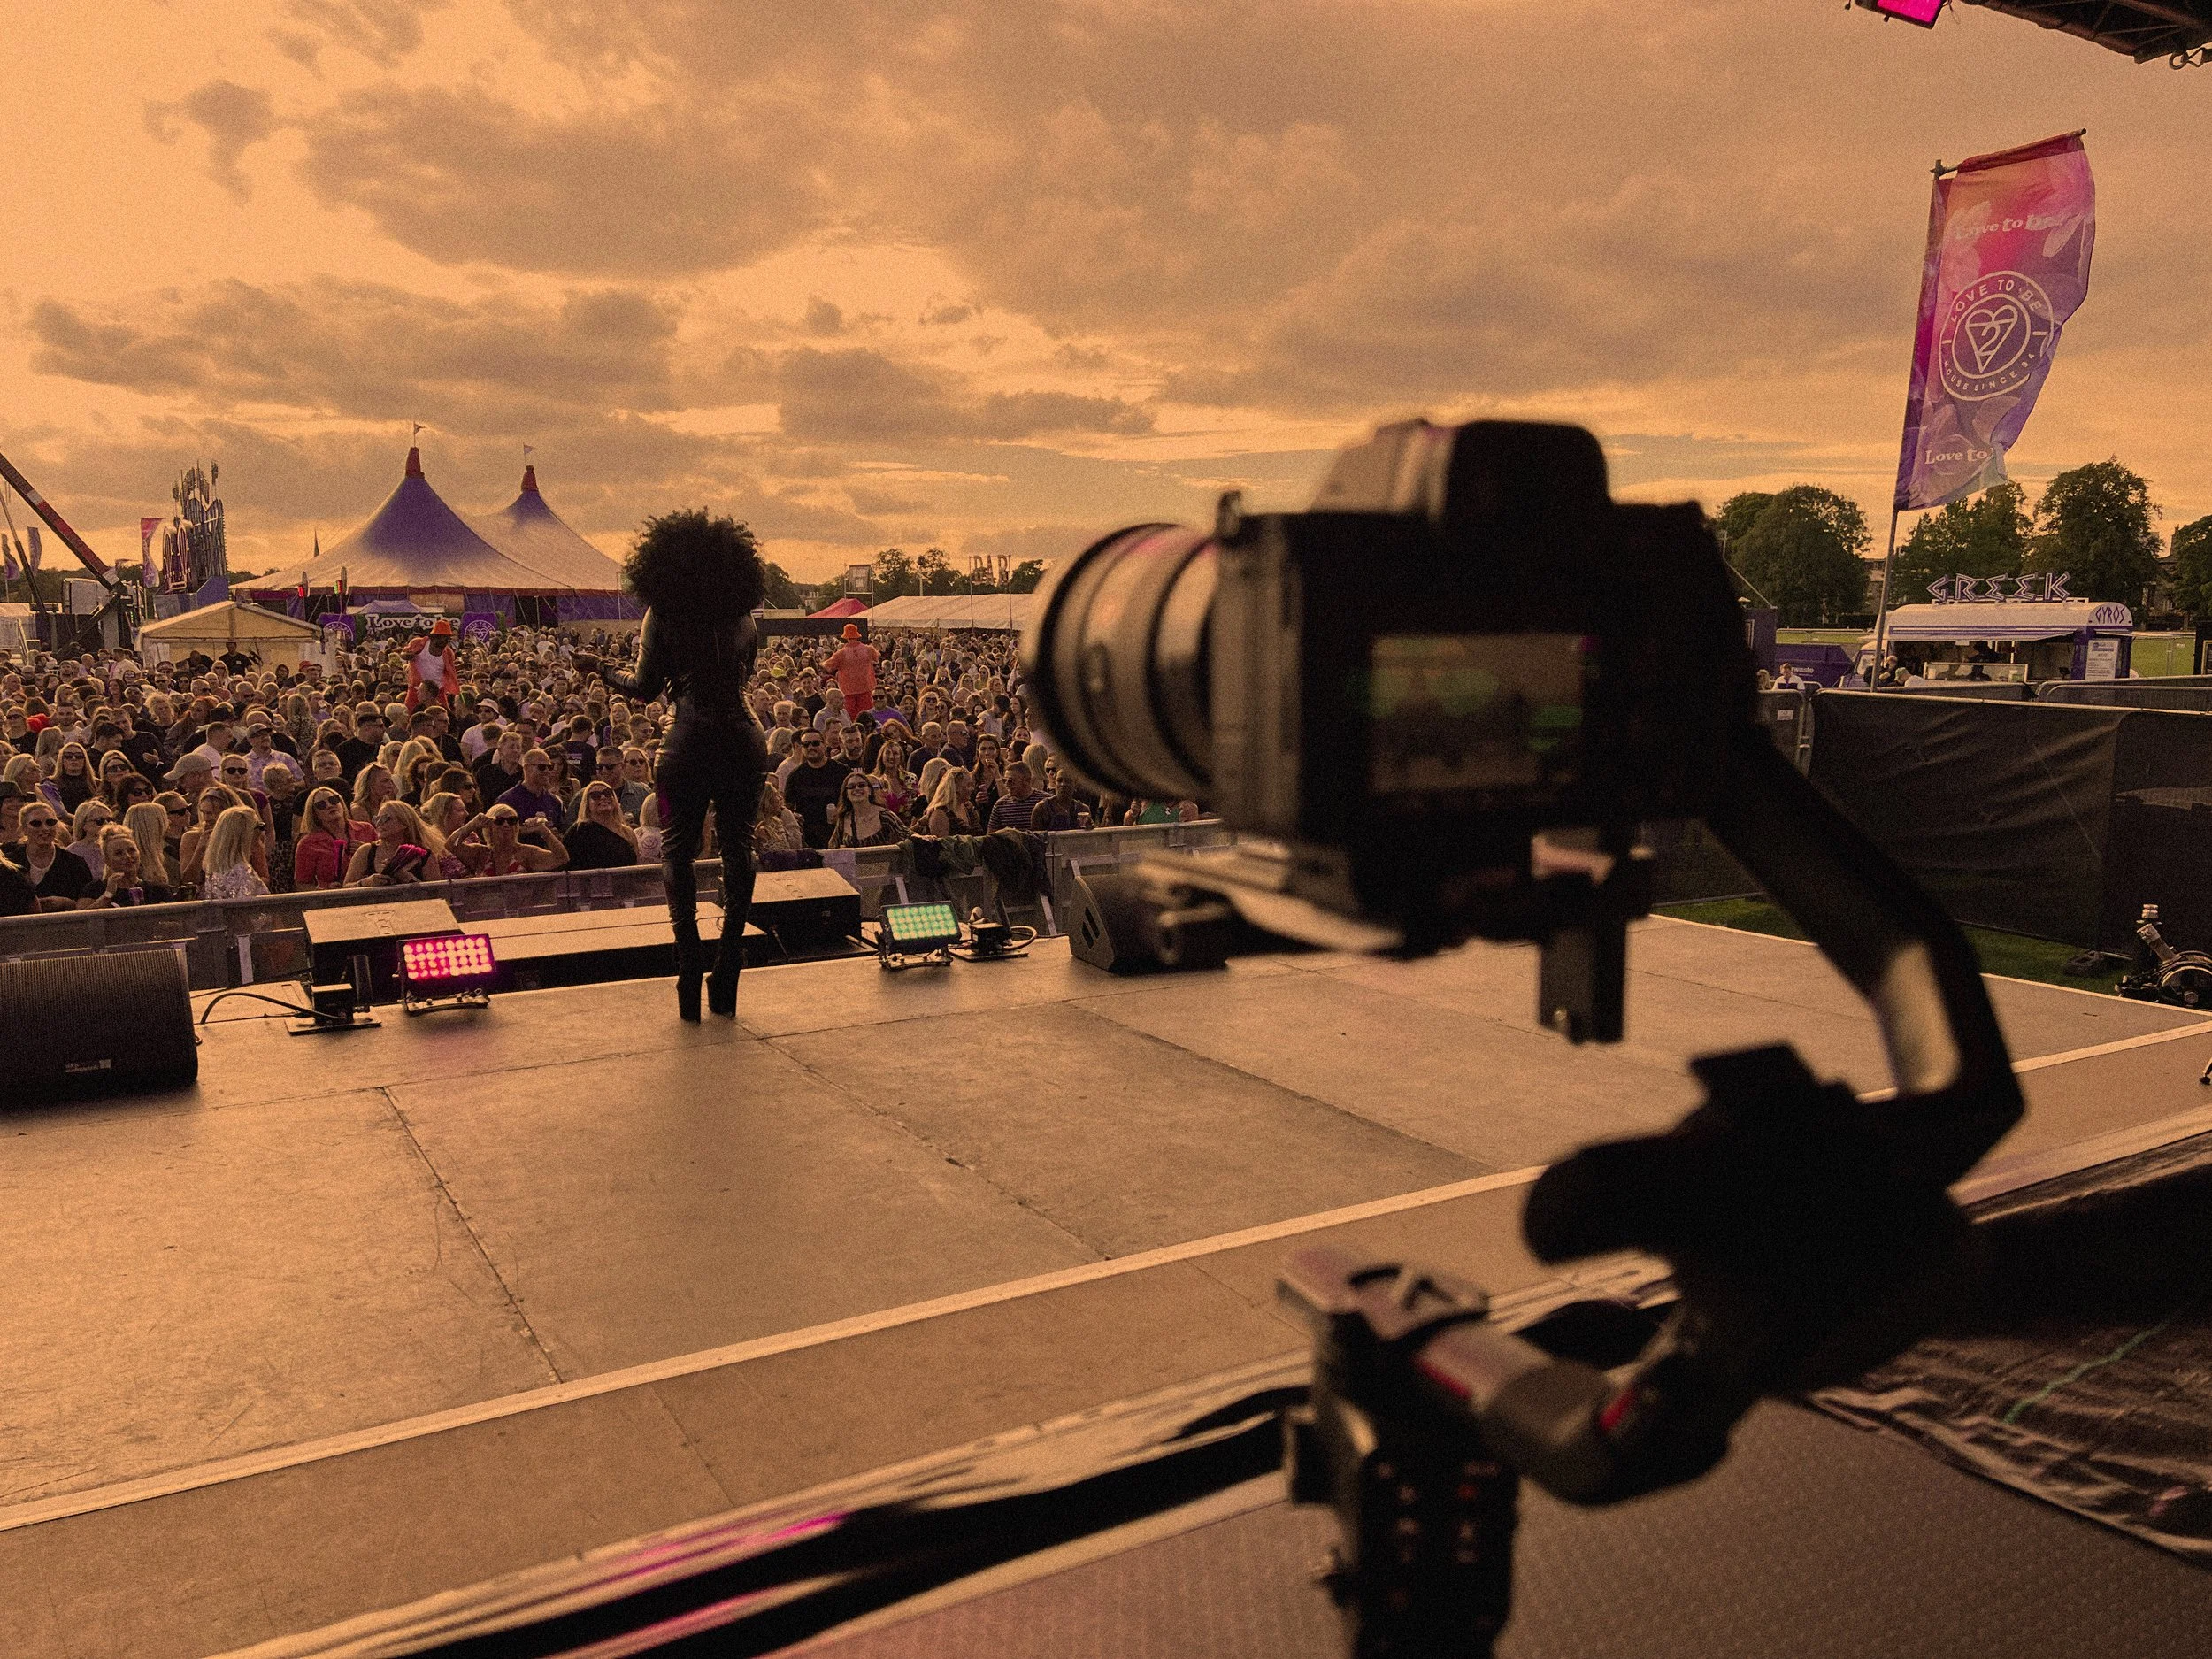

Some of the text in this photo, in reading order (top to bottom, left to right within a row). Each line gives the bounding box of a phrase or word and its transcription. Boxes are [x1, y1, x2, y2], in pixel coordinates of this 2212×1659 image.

[2002, 217, 2024, 232] to
[1950, 279, 2042, 323] LOVE TO BE
[1974, 370, 2017, 391] SINCE
[1924, 449, 1963, 465] Love
[1967, 448, 1988, 461] to
[1926, 572, 2070, 602] GREEK
[365, 614, 413, 631] Love
[413, 614, 434, 629] to
[2095, 606, 2125, 625] GYROS
